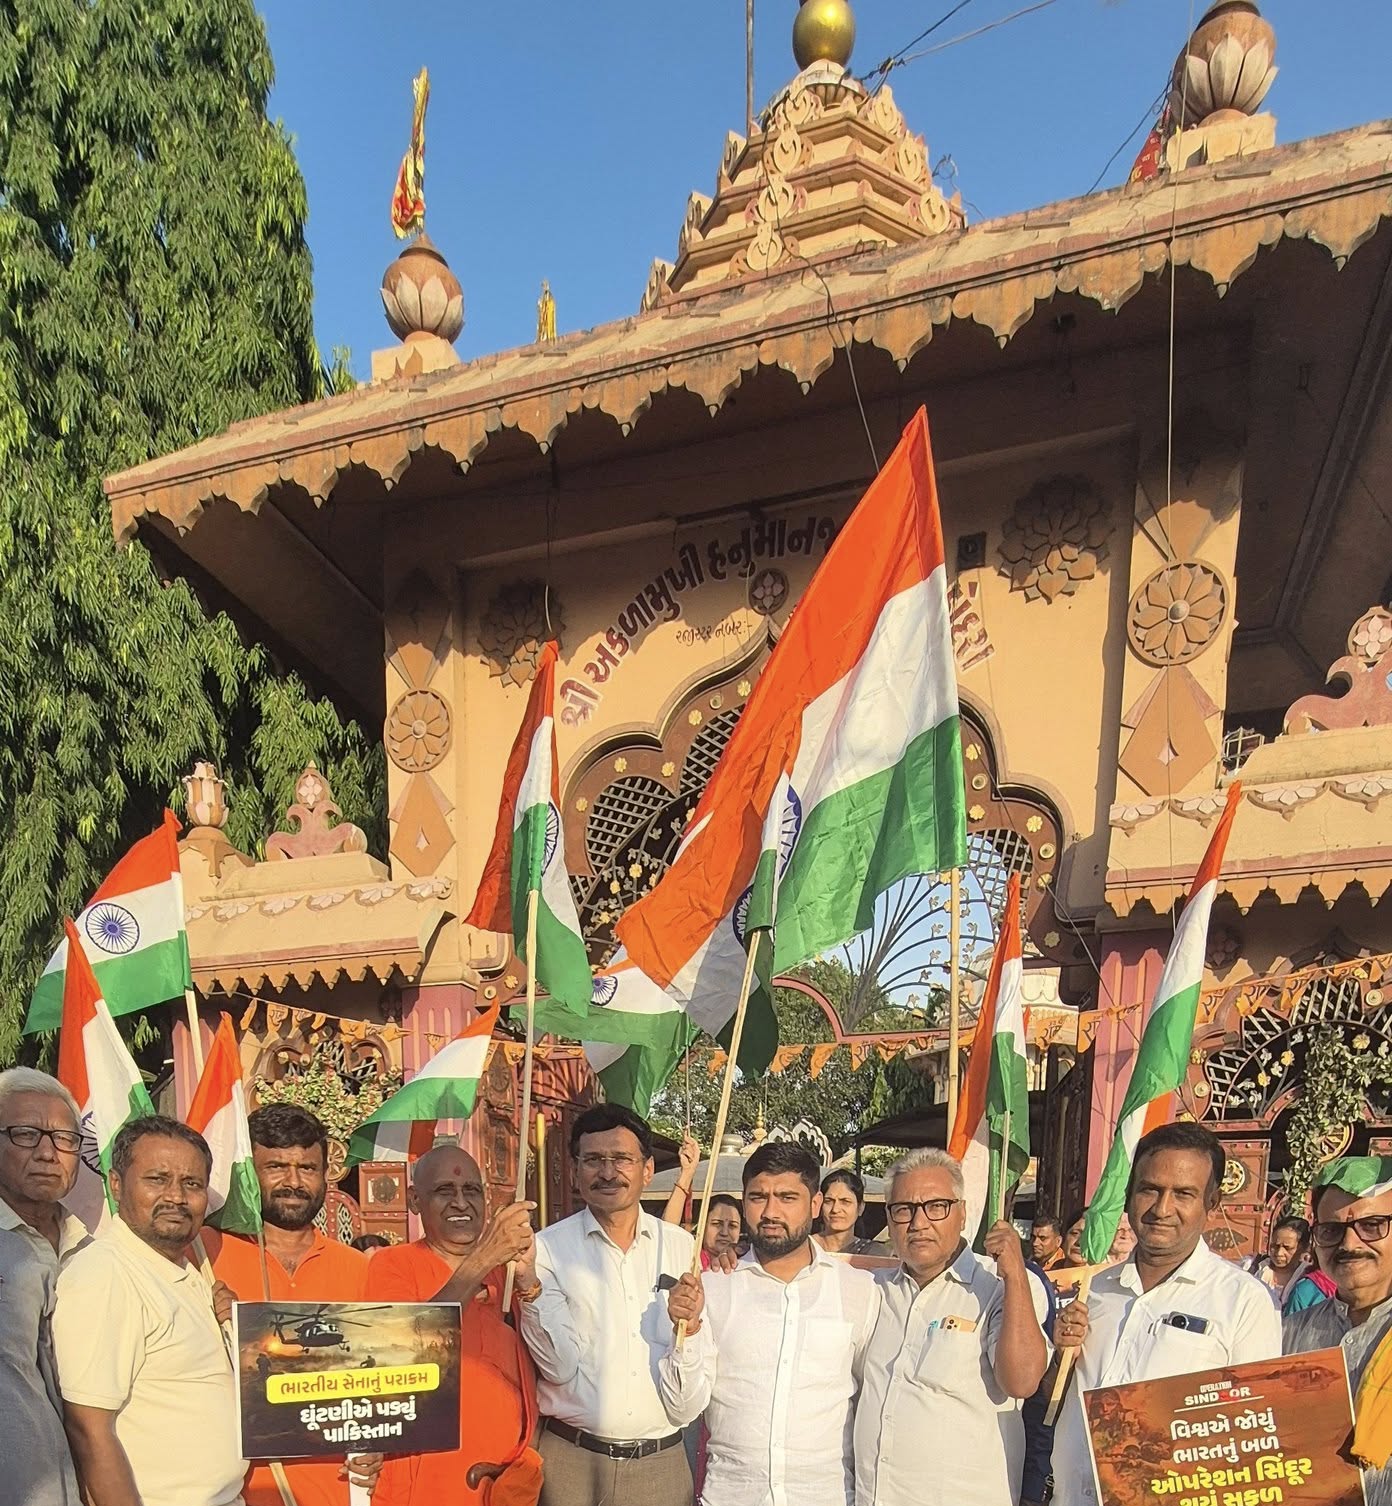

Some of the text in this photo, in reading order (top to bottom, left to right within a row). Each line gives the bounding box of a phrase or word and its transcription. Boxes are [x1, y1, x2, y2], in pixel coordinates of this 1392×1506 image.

[281, 1375, 338, 1395] ભારતીય
[342, 1372, 382, 1393] સેનાનું
[1200, 1381, 1232, 1393] OPERATION
[300, 1398, 372, 1431] ઘૂંટણીએ
[1170, 1407, 1277, 1440] વિશ્વએ જોયું
[323, 1422, 402, 1443] પાકિસ્તાન
[1173, 1435, 1279, 1464] ભારતનું બળ
[1151, 1452, 1313, 1494] ઓપરેશન સિંદૂર
